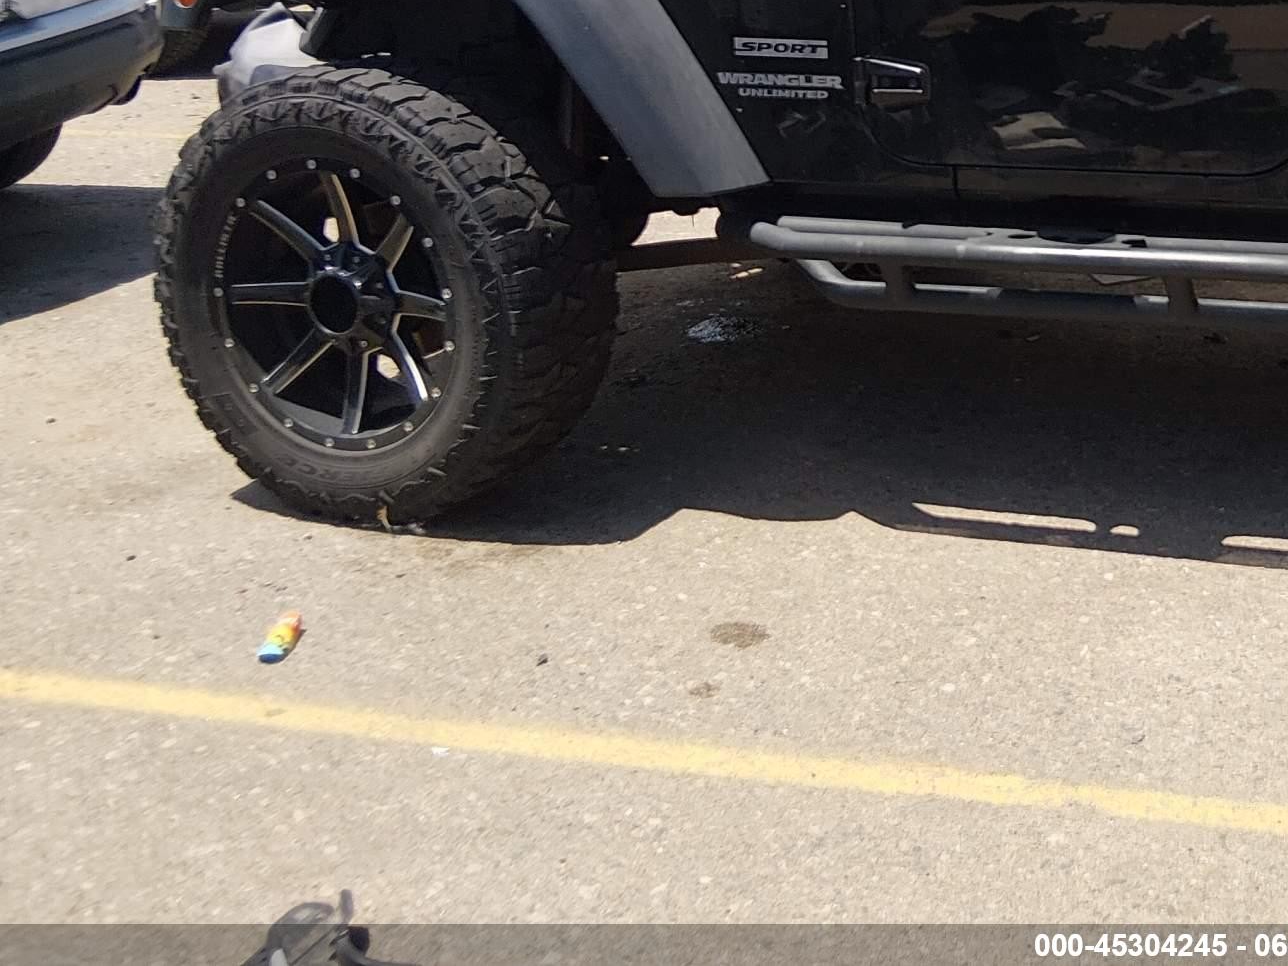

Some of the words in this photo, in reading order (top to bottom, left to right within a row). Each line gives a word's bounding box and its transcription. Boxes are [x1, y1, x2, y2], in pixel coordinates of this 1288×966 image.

[739, 40, 821, 55] SPORT
[717, 72, 845, 89] WRANGLER
[738, 88, 829, 99] UNLIMITED
